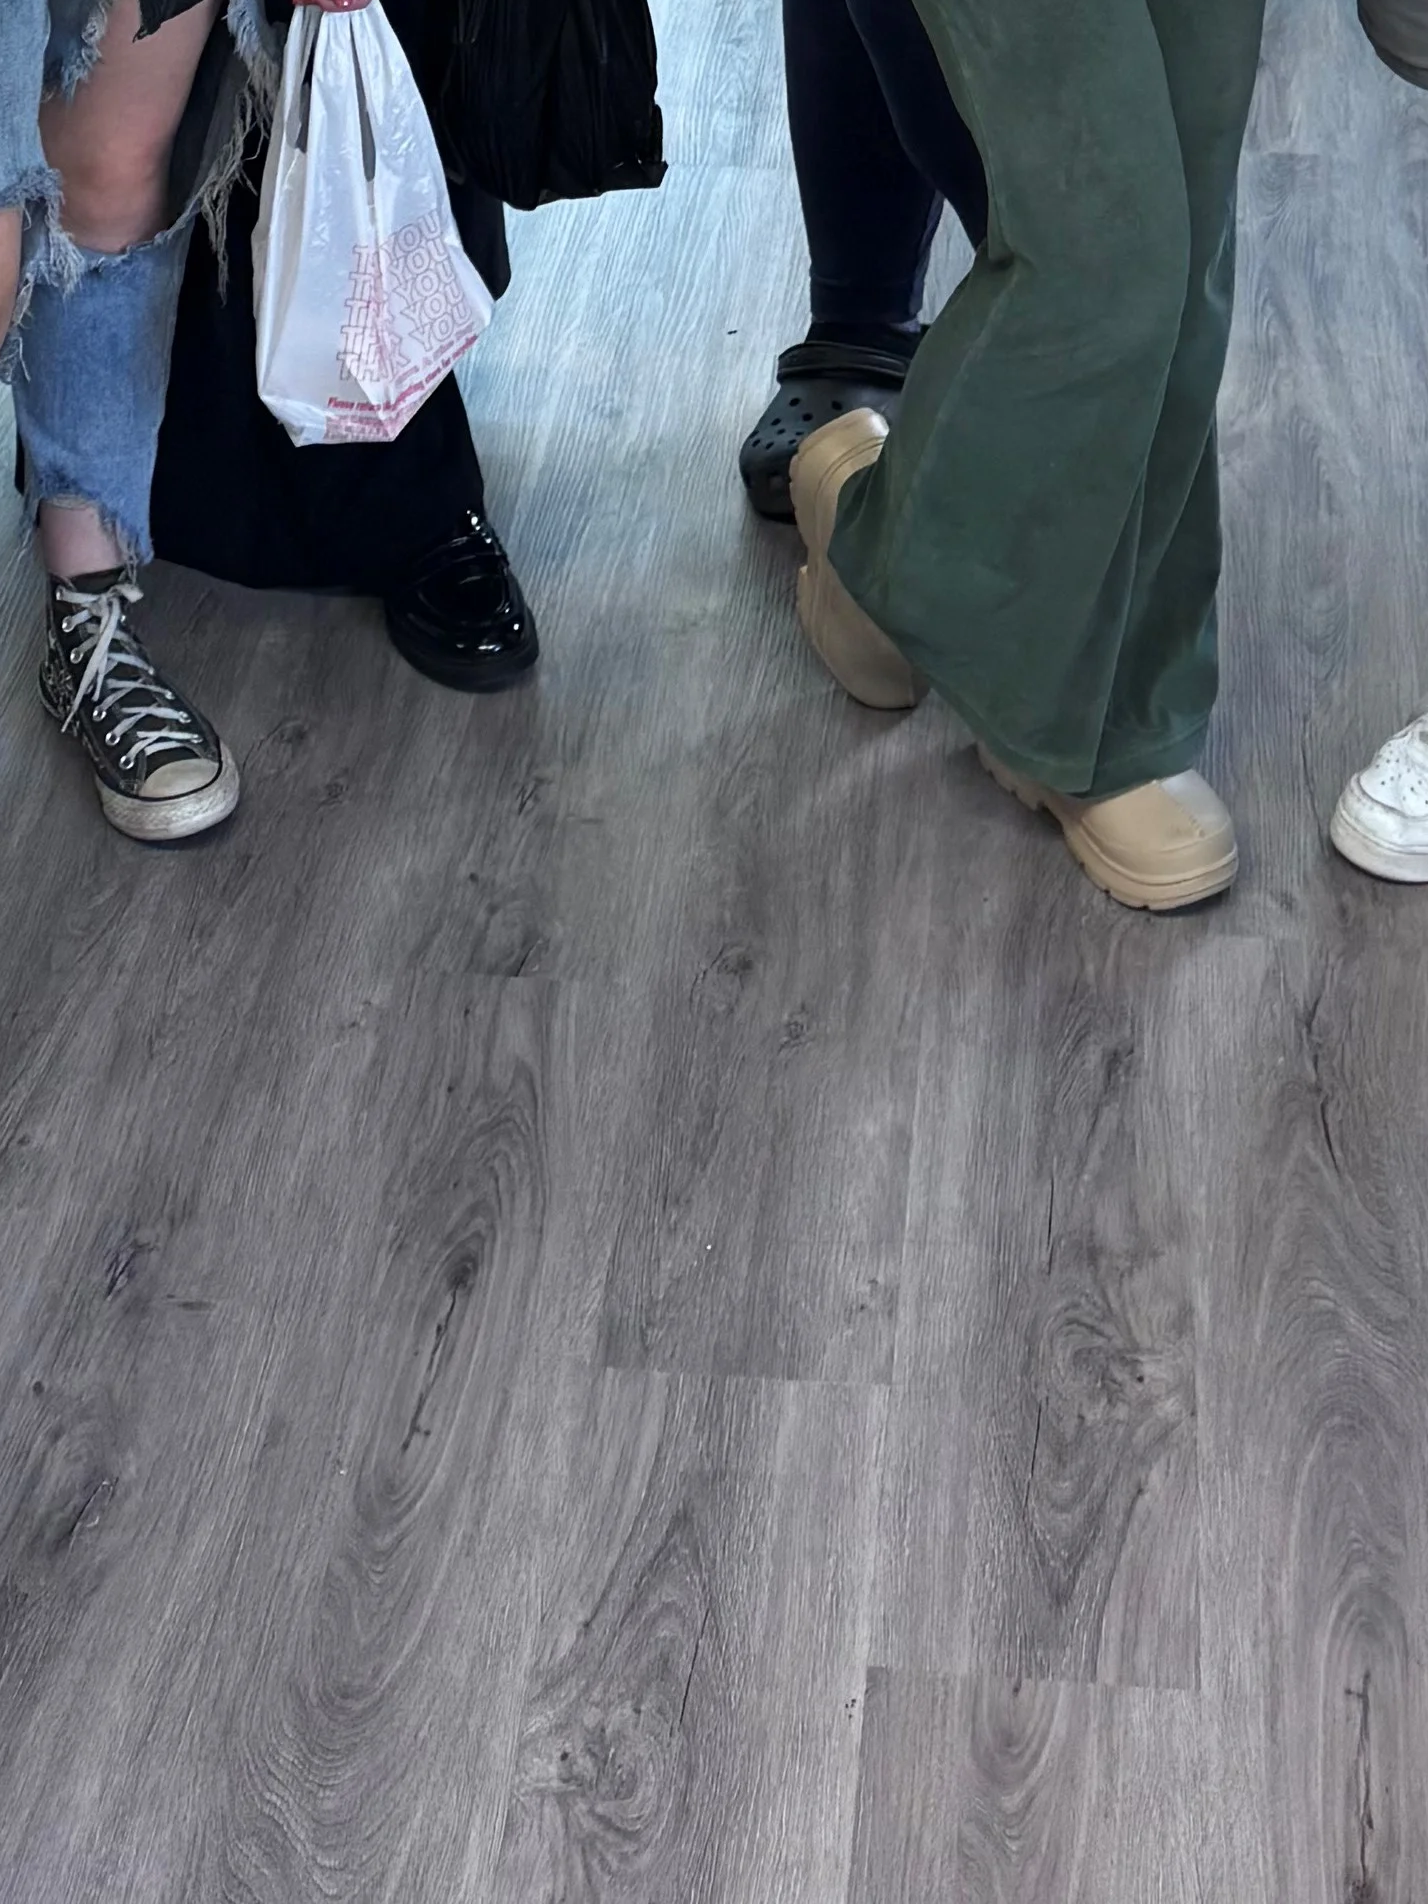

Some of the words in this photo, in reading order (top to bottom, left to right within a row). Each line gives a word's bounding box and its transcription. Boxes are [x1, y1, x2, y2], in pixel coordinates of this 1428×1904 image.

[387, 236, 449, 282] YOU
[393, 260, 456, 308] YOU
[401, 283, 465, 330] YOU
[409, 304, 472, 352] YOU
